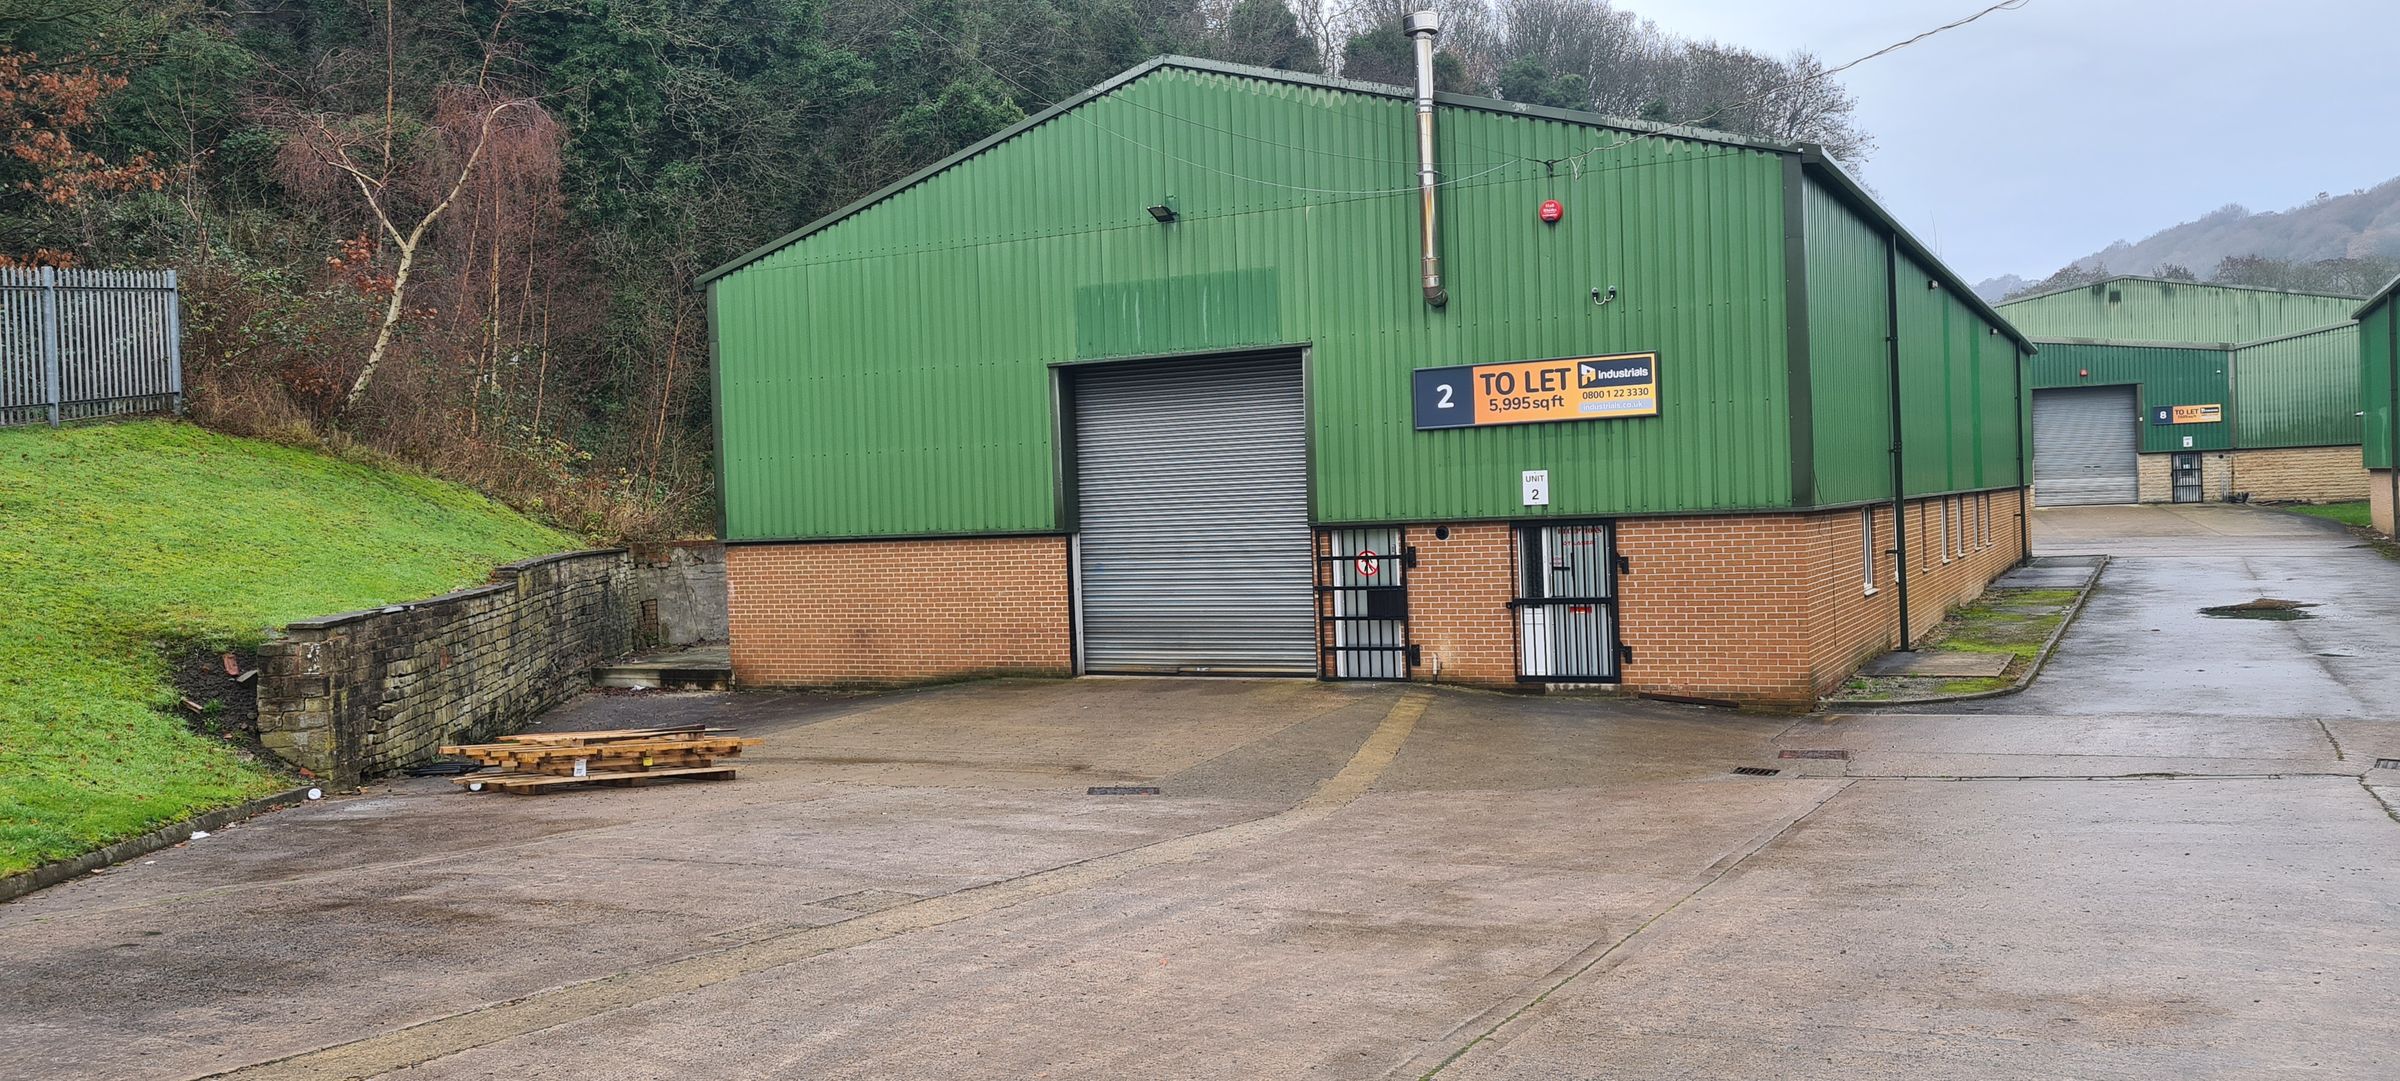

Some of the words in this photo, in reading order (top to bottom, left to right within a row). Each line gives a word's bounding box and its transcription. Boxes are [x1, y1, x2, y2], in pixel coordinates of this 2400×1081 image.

[1480, 371, 1515, 396] TO
[1524, 367, 1571, 393] LET
[1436, 384, 1455, 408] 2
[1582, 390, 1605, 400] 0800
[1606, 390, 1611, 398] 1
[1614, 389, 1625, 397] 22
[1627, 387, 1649, 397] 3330
[1583, 401, 1643, 411] industrials.co.uk
[2160, 411, 2167, 419] 8
[1532, 489, 1539, 500] 2
